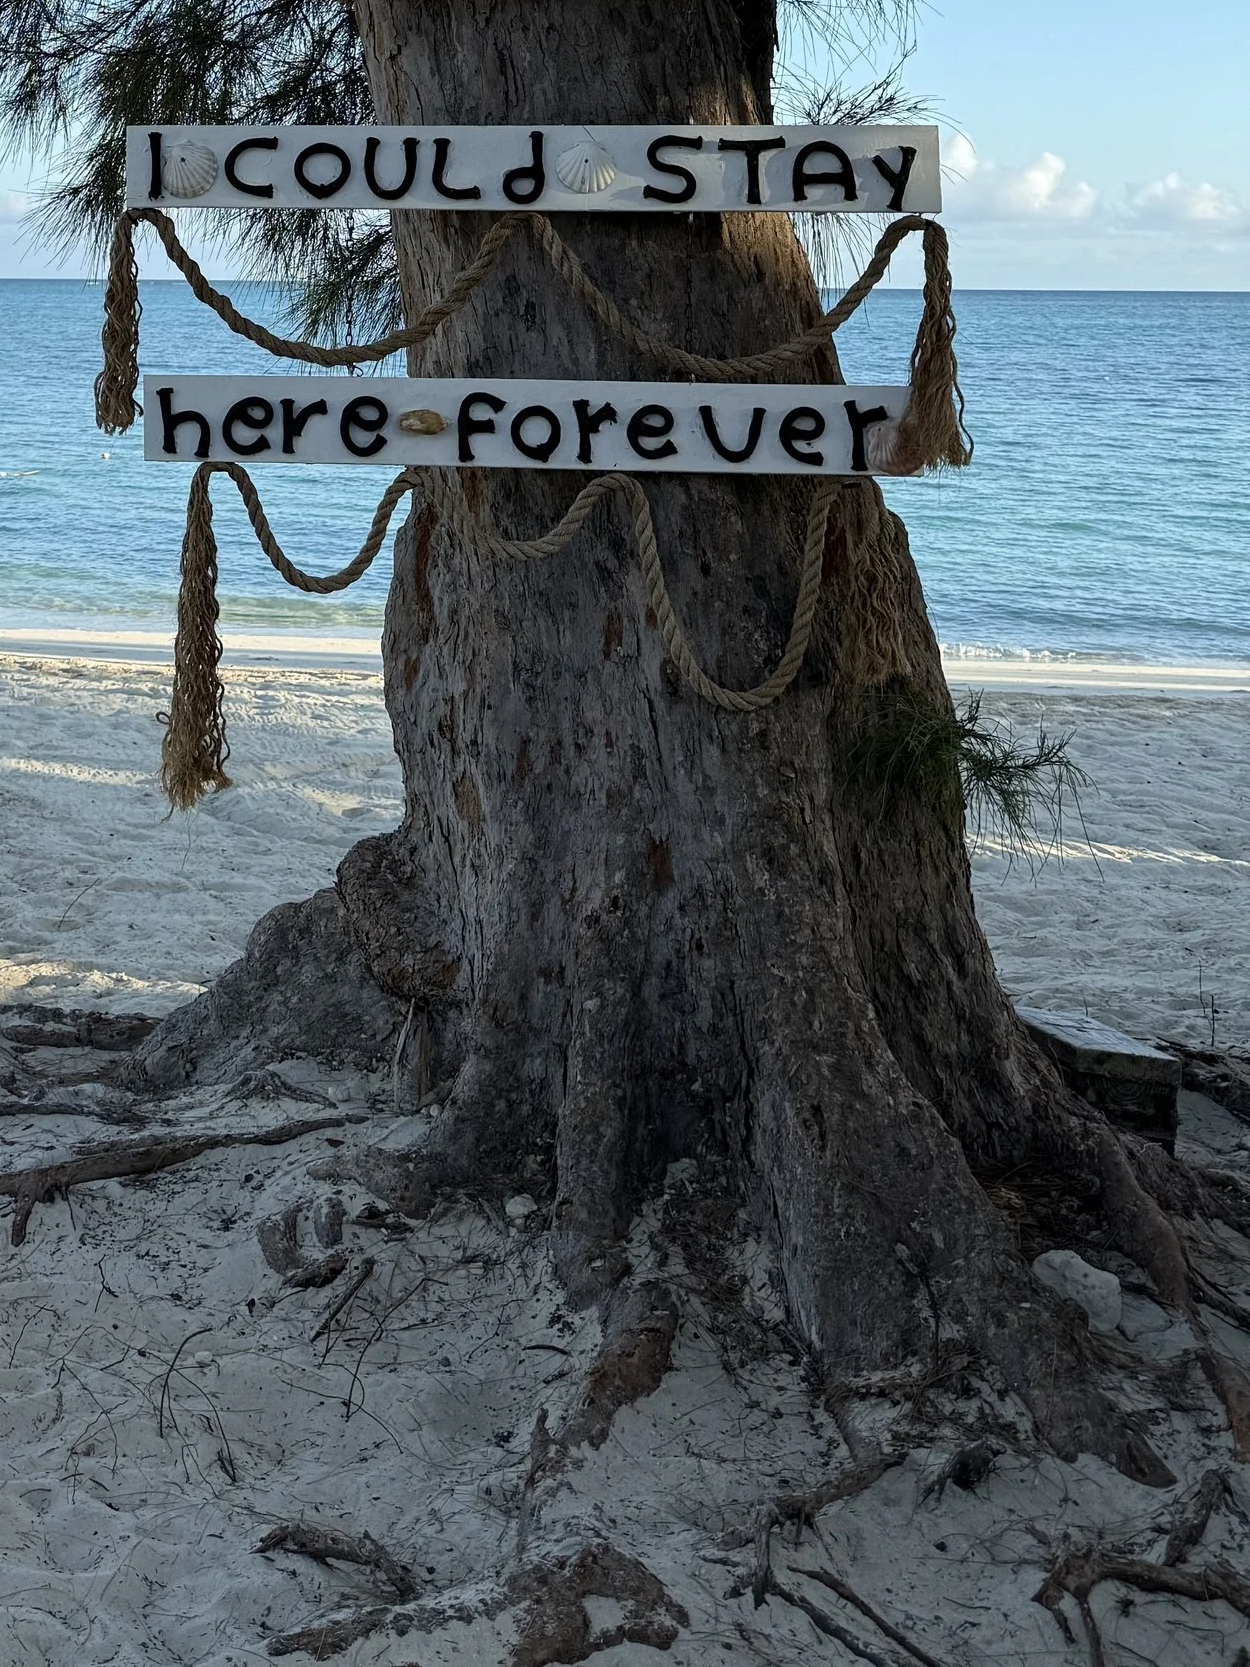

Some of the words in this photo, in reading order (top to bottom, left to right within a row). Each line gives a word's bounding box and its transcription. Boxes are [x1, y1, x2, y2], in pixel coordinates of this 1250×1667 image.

[147, 131, 165, 201] I
[642, 134, 918, 212] STAY
[155, 387, 389, 459] here
